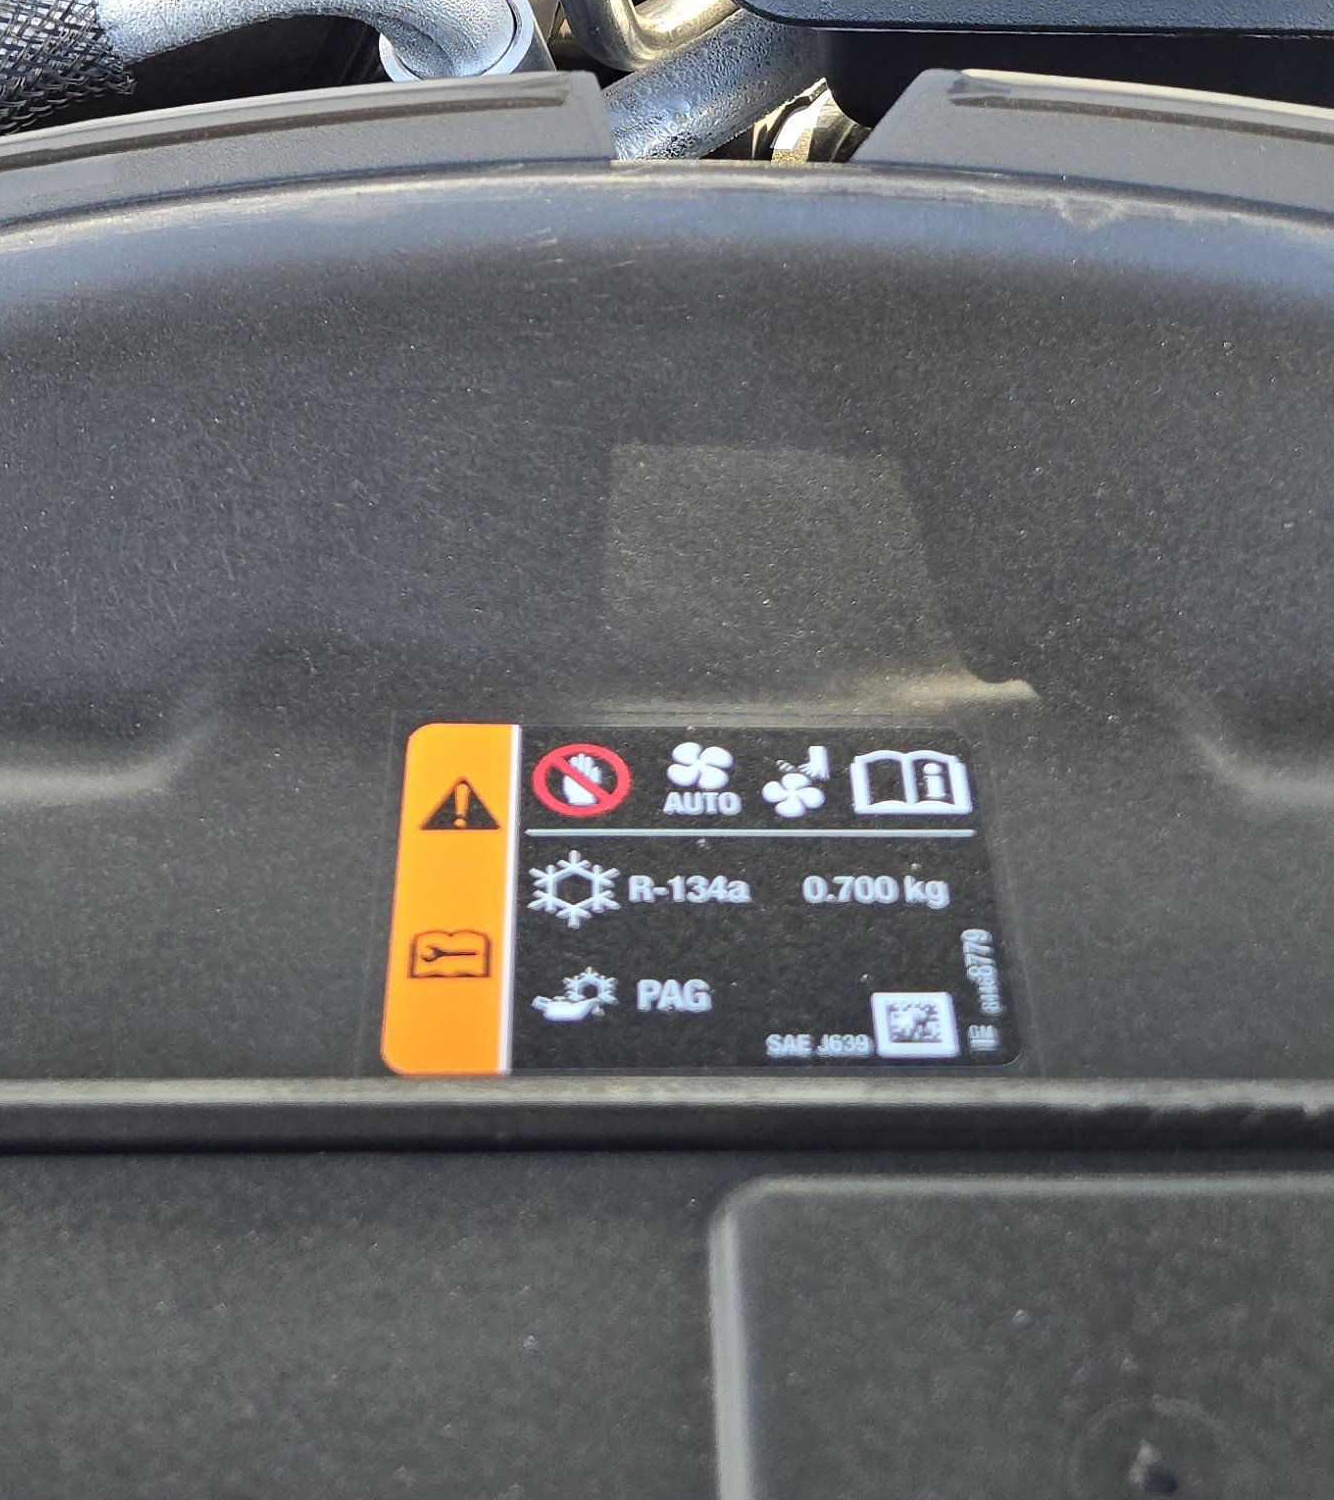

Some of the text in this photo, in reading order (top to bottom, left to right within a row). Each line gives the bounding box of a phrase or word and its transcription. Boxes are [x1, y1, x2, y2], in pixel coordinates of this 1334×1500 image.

[663, 791, 741, 816] AUTO
[627, 874, 951, 910] R-134a 0.700 kg
[635, 978, 714, 1013] PAG
[765, 1033, 872, 1057] SAE J639
